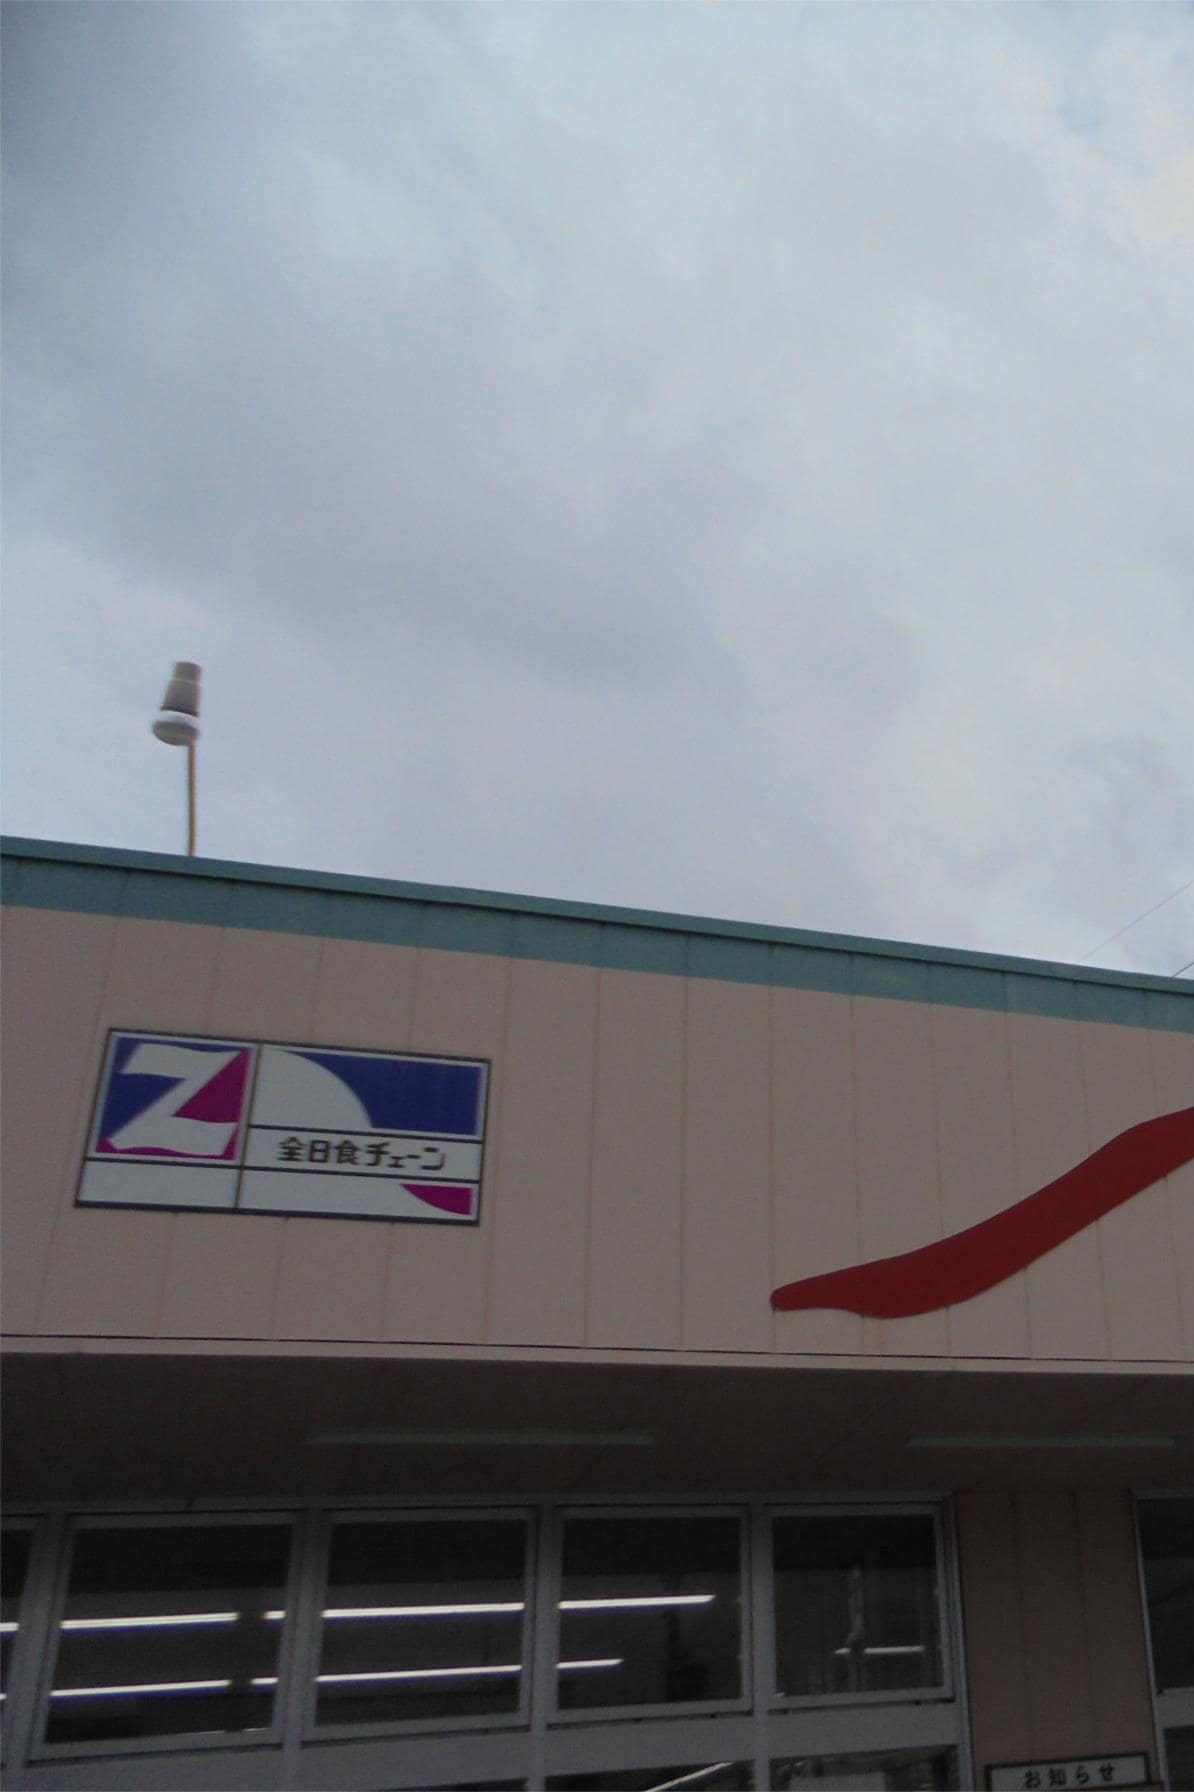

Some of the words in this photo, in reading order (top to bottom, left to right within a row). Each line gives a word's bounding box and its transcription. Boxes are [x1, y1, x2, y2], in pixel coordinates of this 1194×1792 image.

[277, 1136, 446, 1171] 全日食チェーン
[1024, 1762, 1114, 1789] お知らせ
